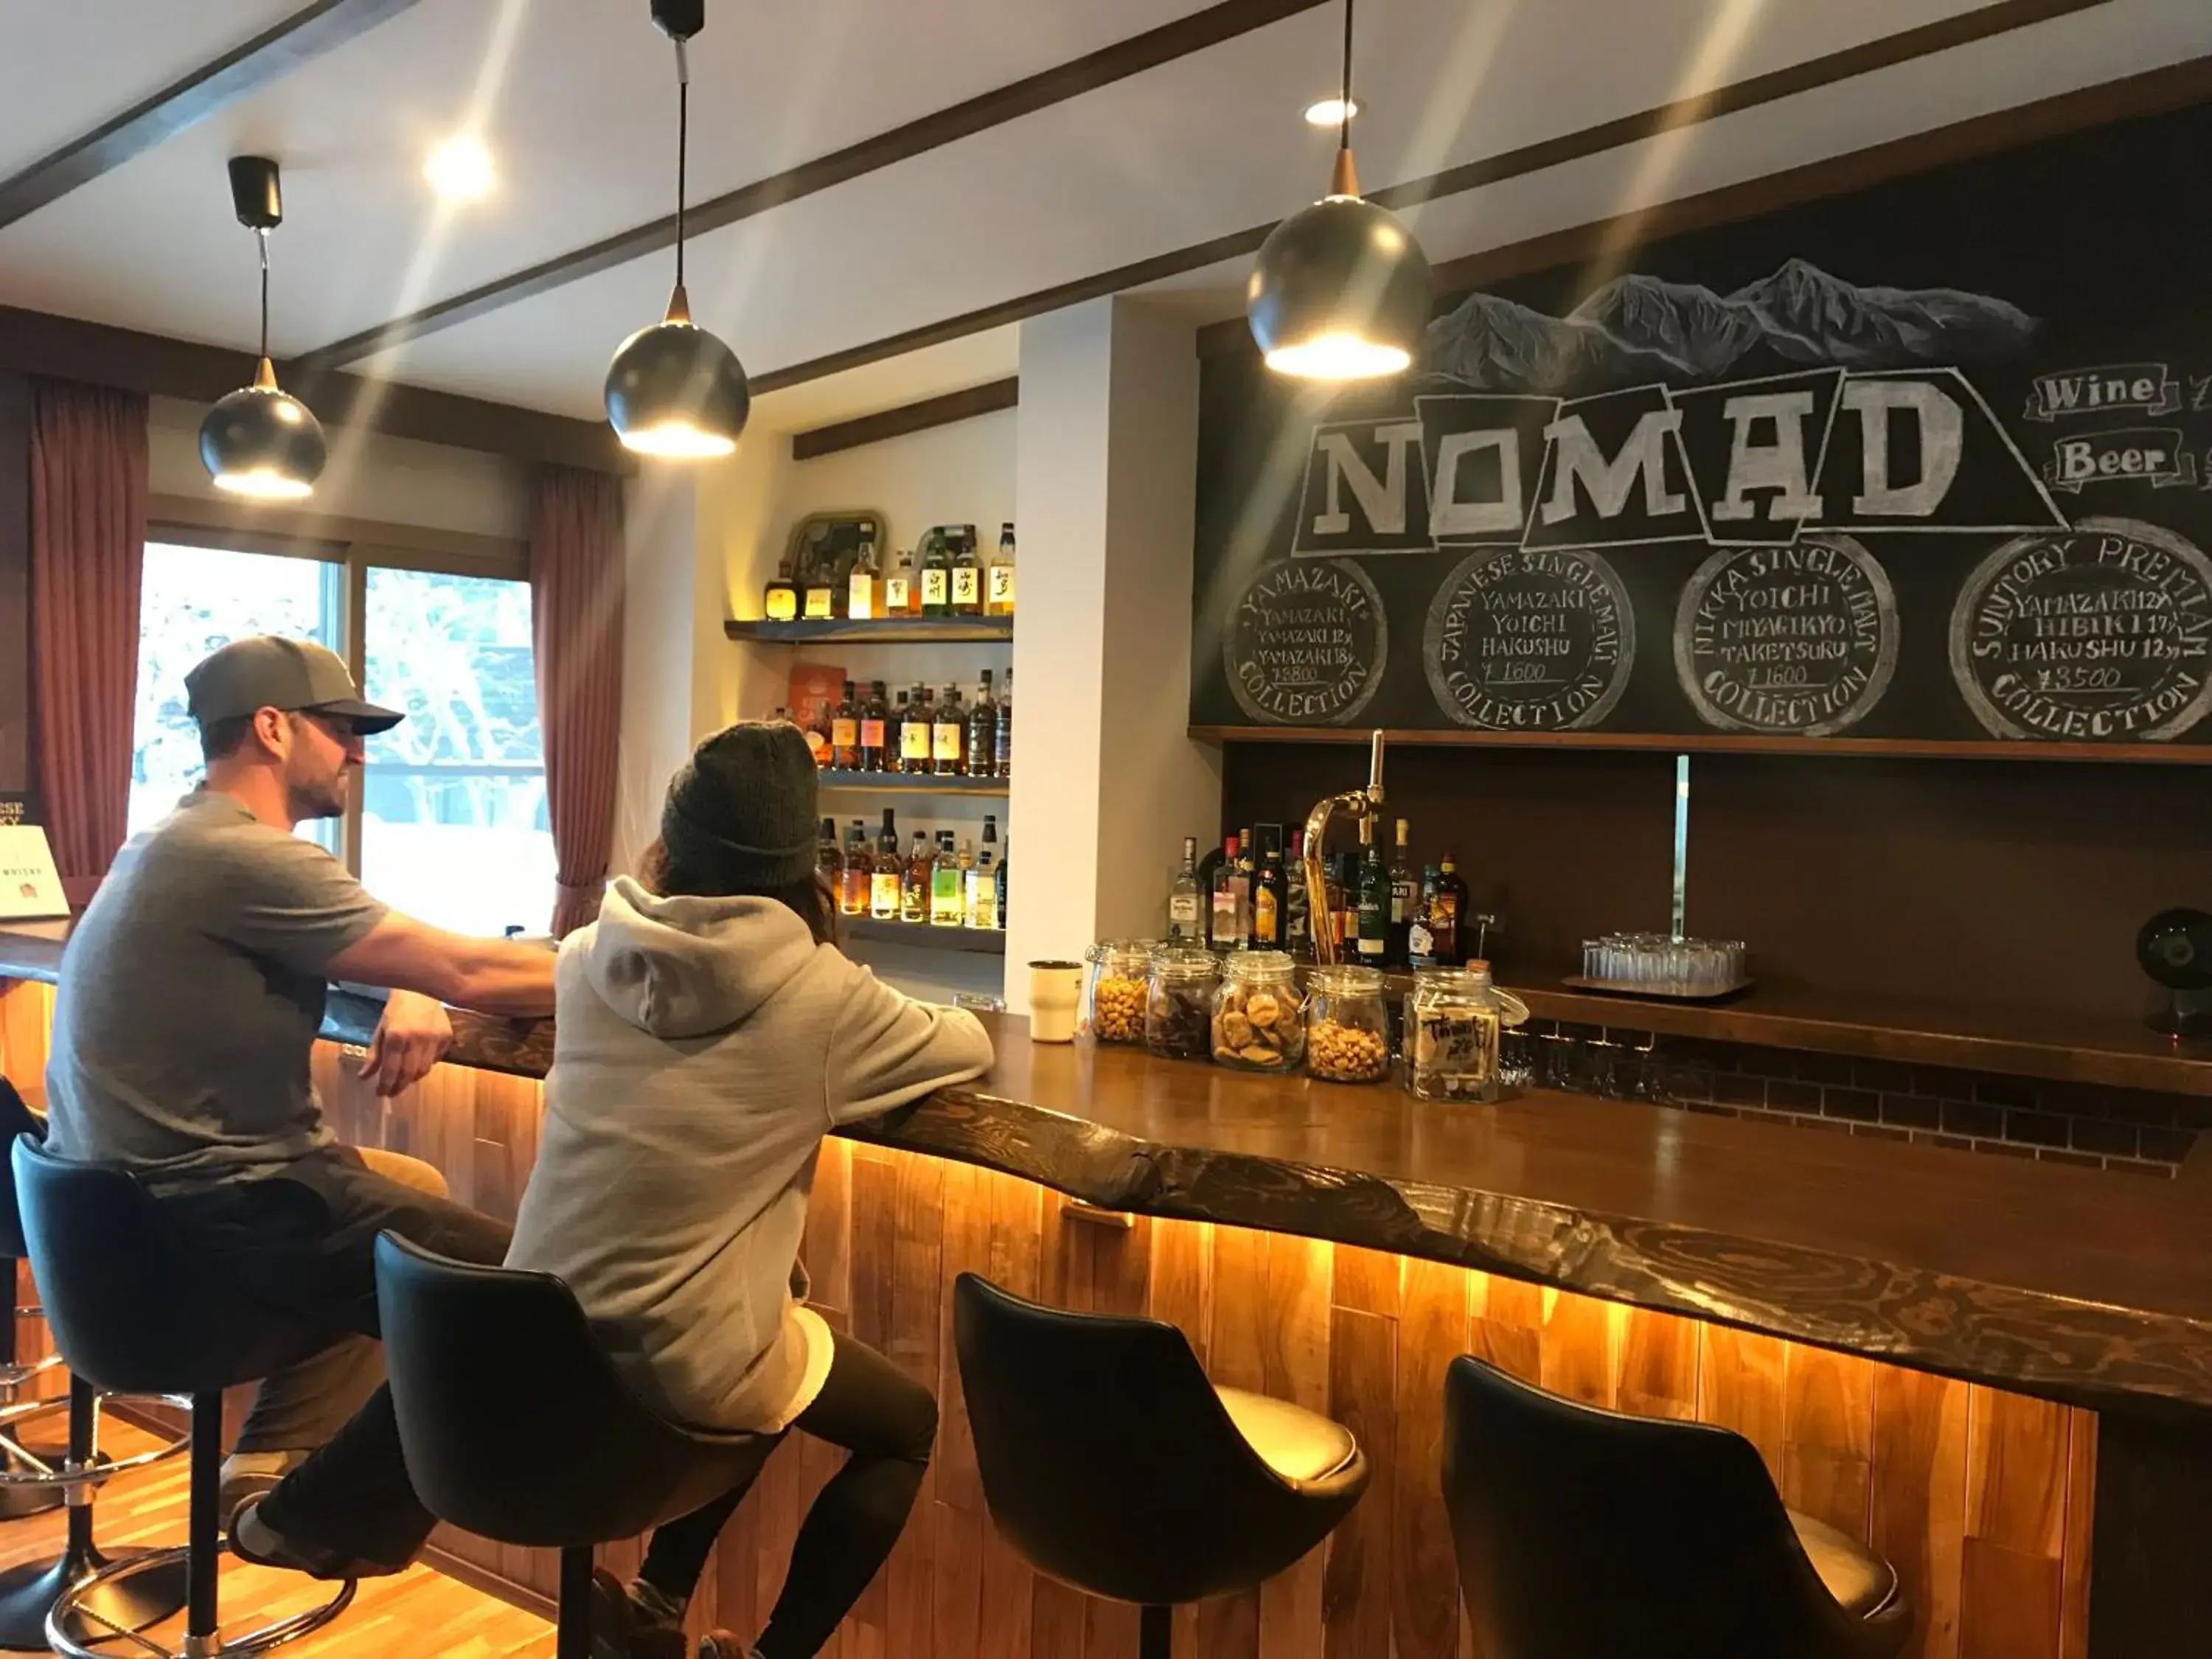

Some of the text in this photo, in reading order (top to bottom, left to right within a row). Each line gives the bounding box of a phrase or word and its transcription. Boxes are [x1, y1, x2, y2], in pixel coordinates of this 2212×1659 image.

[2045, 375, 2154, 410] Wine
[1313, 380, 1964, 538] NOMAD
[2061, 442, 2166, 479] Beer
[1242, 567, 1366, 613] YAMAZAKI
[1481, 589, 1585, 611] YAMAZAKI
[1694, 547, 1878, 655] NIKKA SINGLE MALT
[1734, 584, 1830, 612] YOICHI
[1973, 539, 2076, 658] SUNTORY
[2015, 590, 2136, 618] YAMAZAKI
[1262, 608, 1344, 625] YAMAZAKI
[1441, 553, 1618, 666] JAPANESE SINGLE MALT
[1258, 629, 1328, 644] YAMAZAKI
[1492, 614, 1566, 634] YOICHI
[1722, 613, 1846, 639] MIYAGIKYO
[2035, 614, 2142, 637] HIBIKI
[1258, 648, 1331, 665] YAMAZAKI
[1482, 637, 1571, 656] HAKUSHU
[1720, 640, 1846, 663] TAKETSURU
[2008, 639, 2137, 662] HAKUSHU
[1239, 661, 1367, 717] COLLECTION
[2037, 667, 2121, 690] ¥3500
[1447, 670, 1604, 726] COLLECTION
[1703, 666, 1868, 726] COLLECTION
[1992, 671, 2200, 737] COLLECTION
